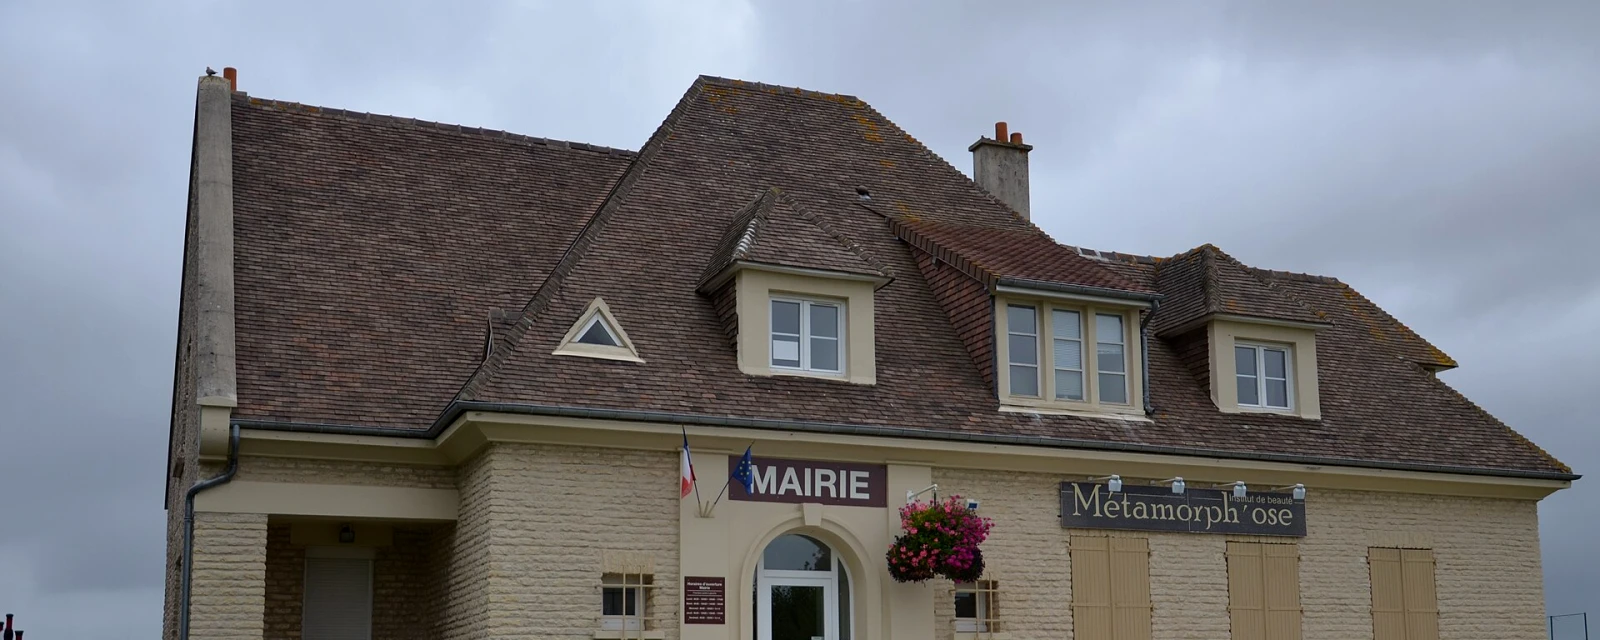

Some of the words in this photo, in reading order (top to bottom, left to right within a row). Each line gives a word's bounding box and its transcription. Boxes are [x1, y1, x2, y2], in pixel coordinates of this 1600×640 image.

[750, 464, 870, 500] MAIRIE
[1229, 494, 1254, 503] Institut
[1256, 496, 1265, 504] de
[1268, 496, 1293, 505] beauté
